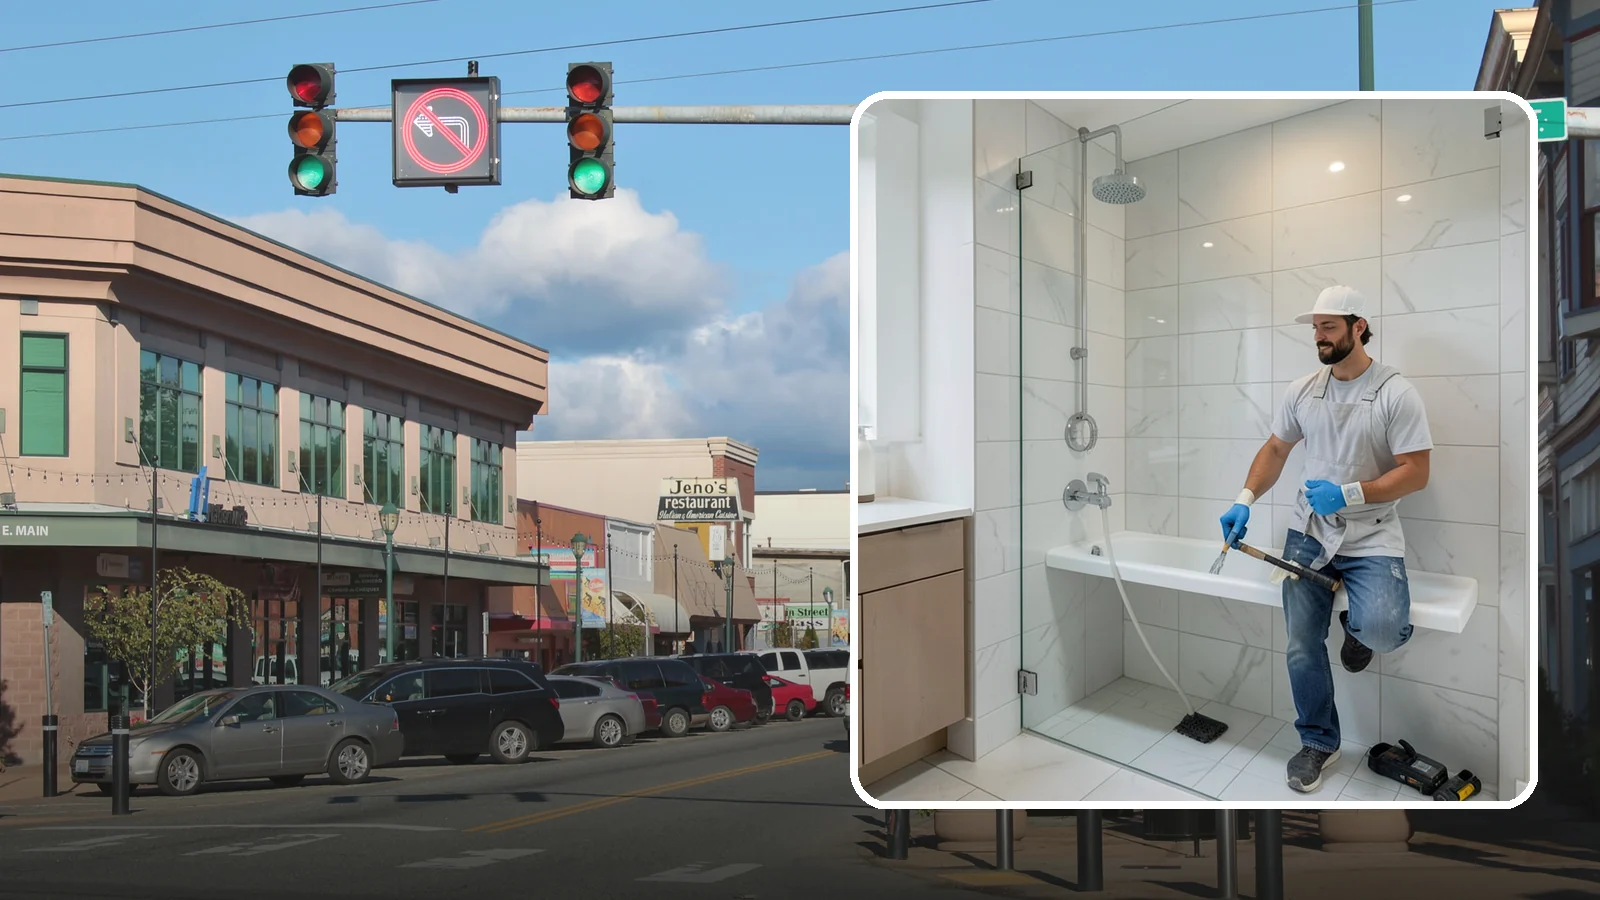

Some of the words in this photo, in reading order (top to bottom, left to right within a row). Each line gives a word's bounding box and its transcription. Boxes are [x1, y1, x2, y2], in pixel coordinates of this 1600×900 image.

[669, 480, 728, 495] Jeno's
[665, 496, 731, 509] restaurant
[658, 510, 681, 520] Italian
[686, 509, 714, 519] American
[715, 509, 737, 519] Cuisine
[2, 525, 13, 536] E.
[15, 525, 49, 537] MAIN
[797, 607, 828, 617] Street
